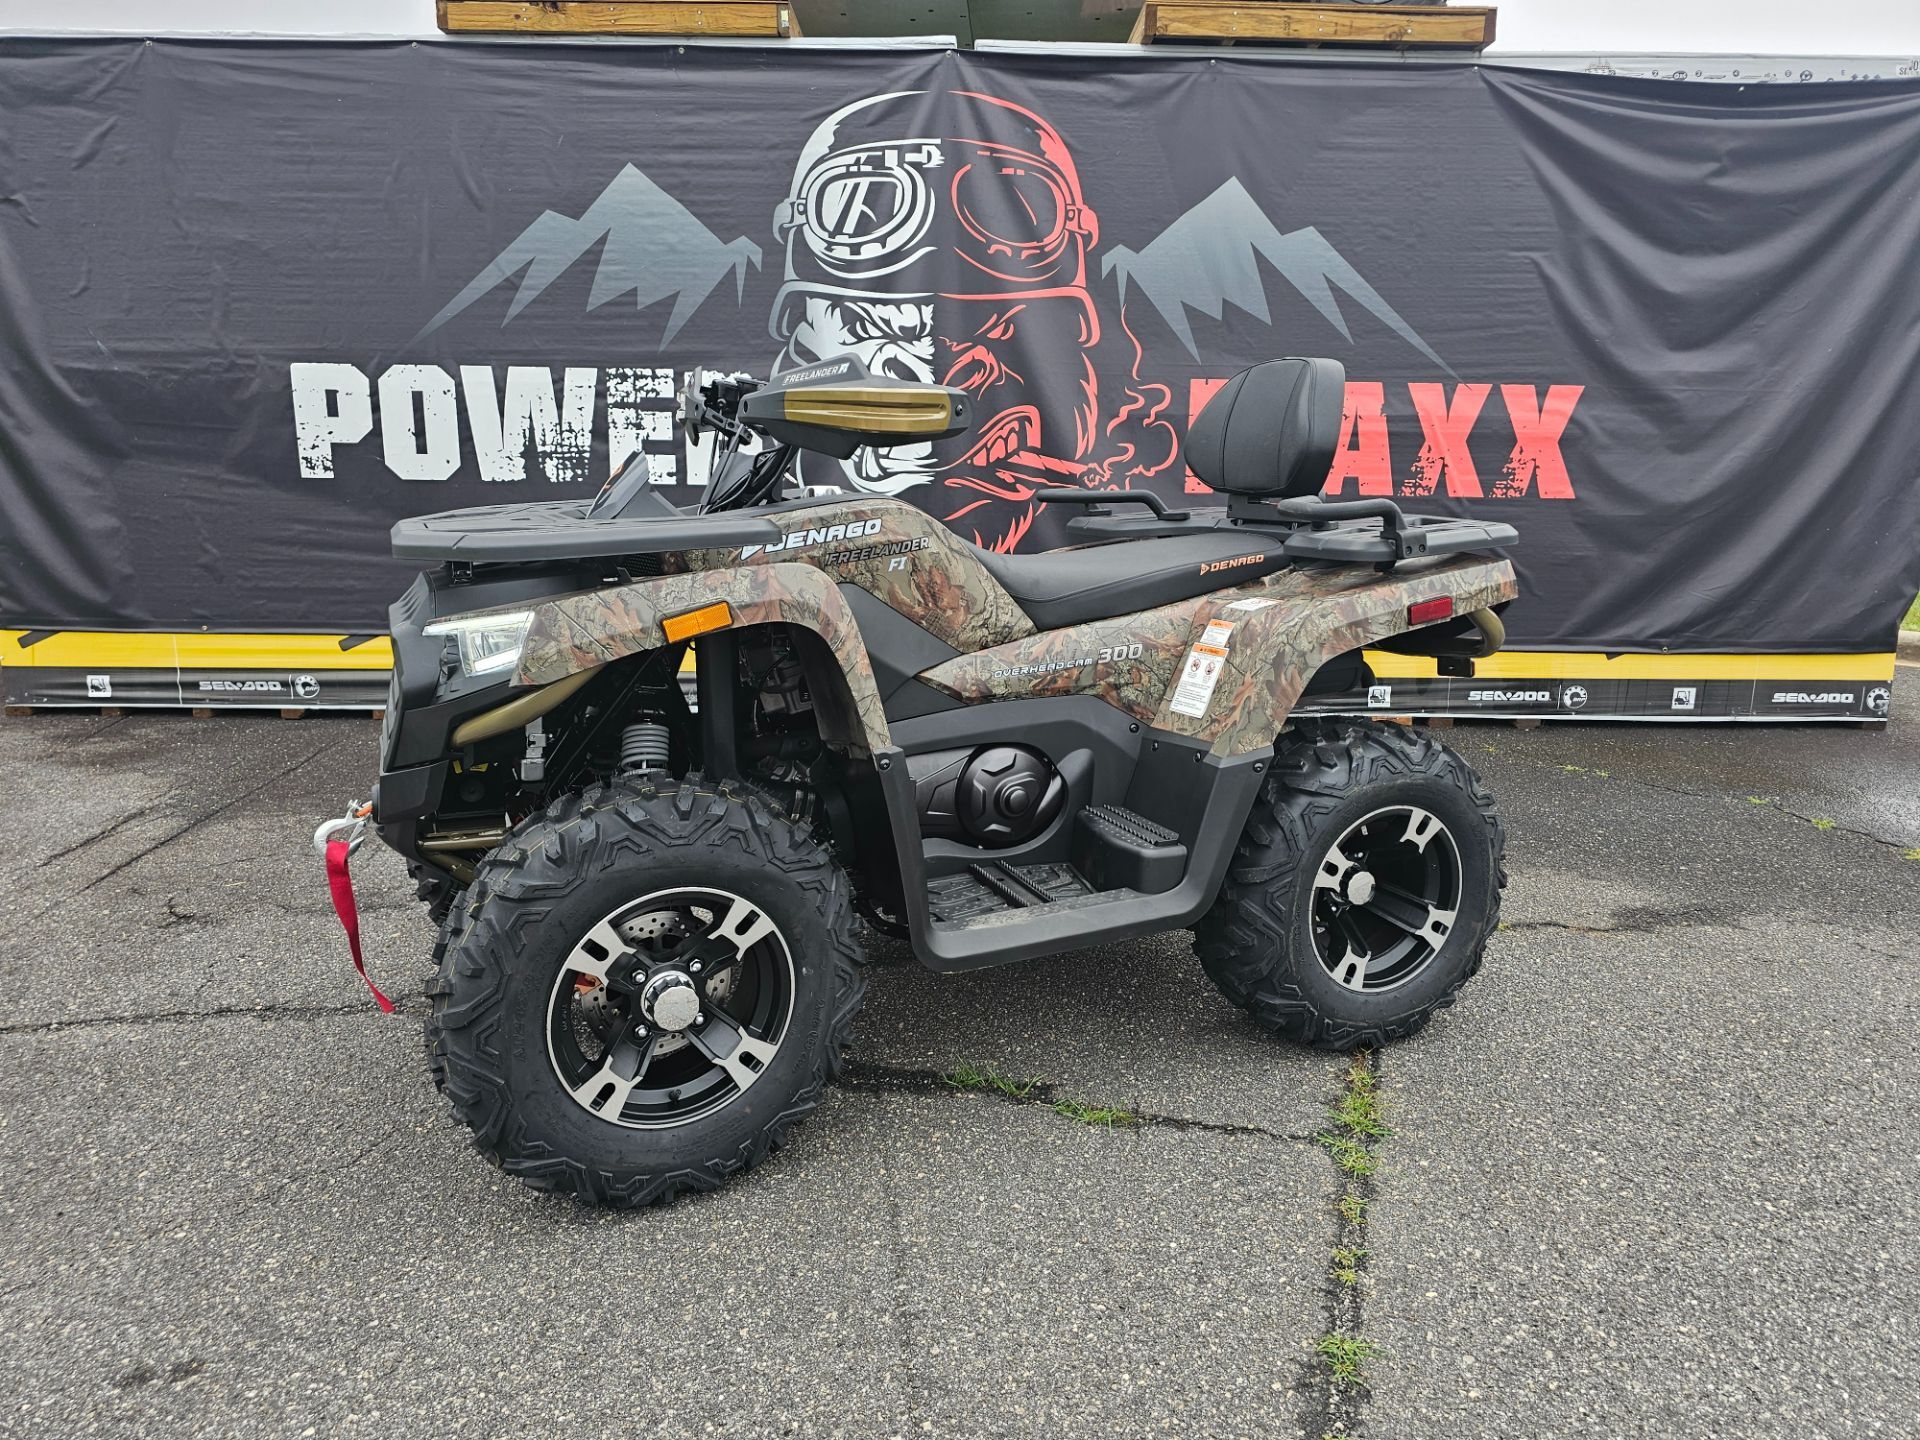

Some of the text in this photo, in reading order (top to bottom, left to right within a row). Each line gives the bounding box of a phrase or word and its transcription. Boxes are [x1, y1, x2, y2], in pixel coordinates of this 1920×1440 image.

[784, 365, 839, 386] FREELANDER
[1184, 378, 1585, 499] AXX
[826, 537, 930, 567] FREELANDER
[888, 556, 907, 573] FI
[1210, 554, 1265, 572] DENAGO
[994, 643, 1143, 678] OVERHEAD CAM 300
